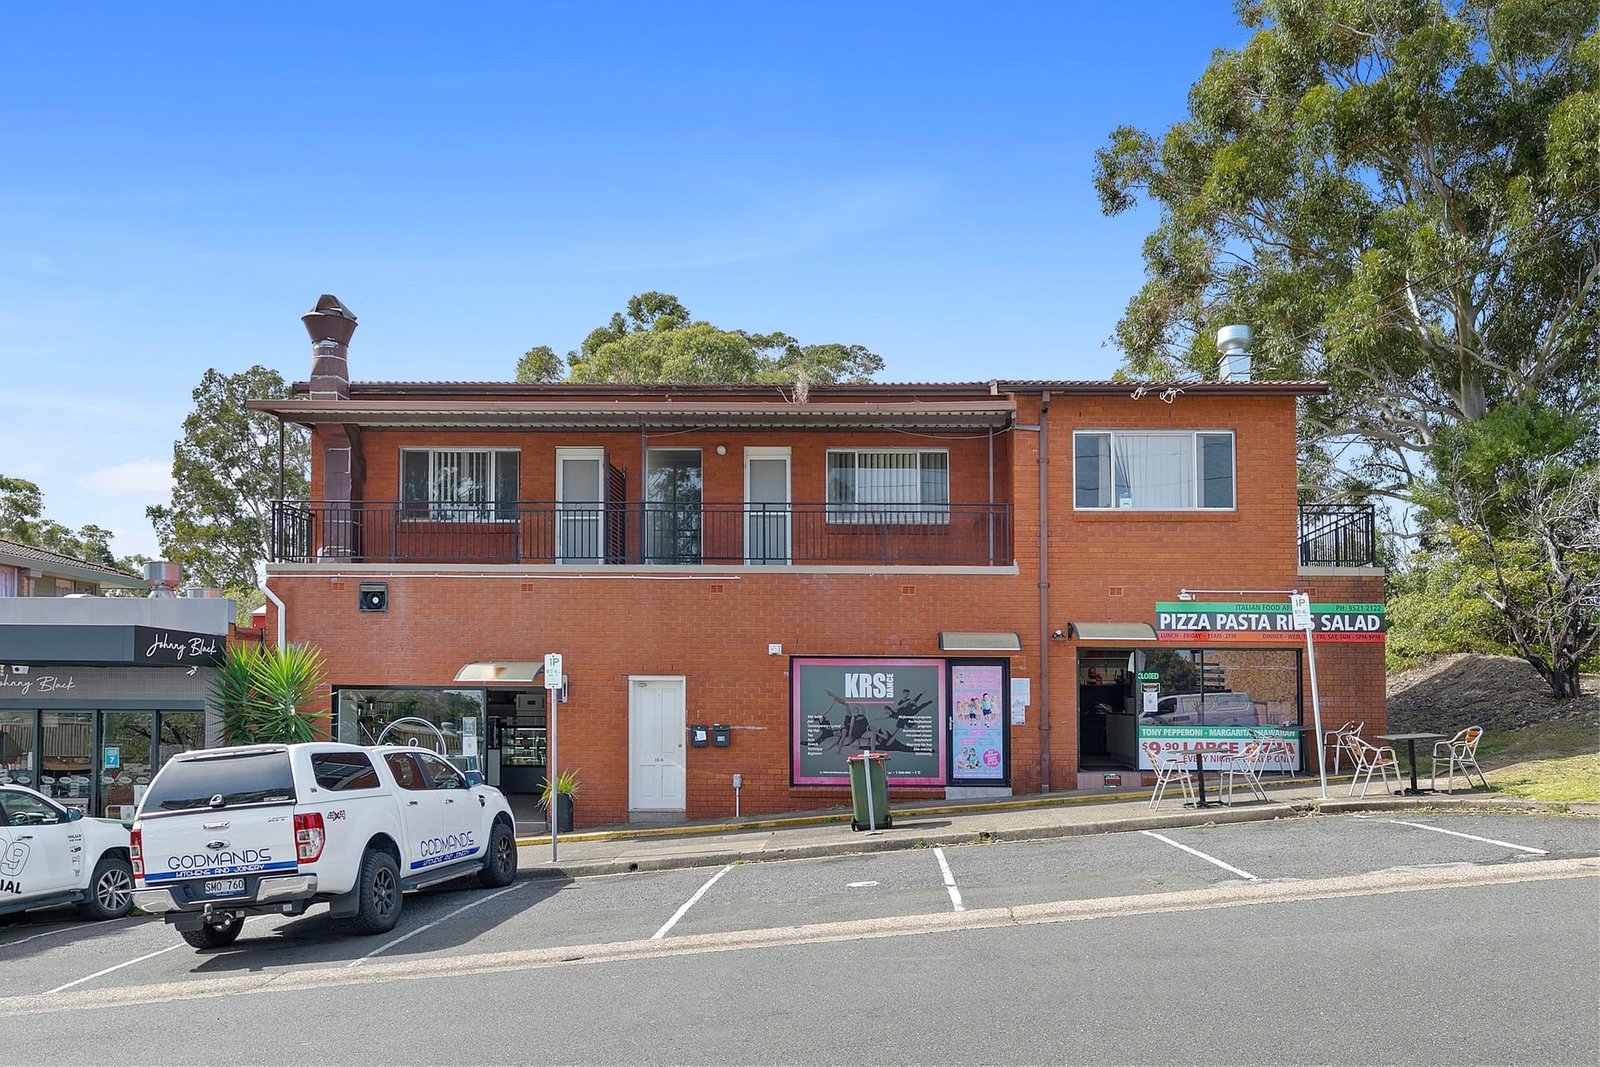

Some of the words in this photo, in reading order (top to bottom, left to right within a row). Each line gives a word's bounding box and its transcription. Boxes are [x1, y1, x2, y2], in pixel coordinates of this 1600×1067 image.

[1295, 599, 1306, 607] 1P
[1160, 613, 1211, 630] PIZZA
[1216, 614, 1271, 631] PASTA
[1276, 614, 1316, 631] RIS
[1321, 614, 1381, 632] SALAD
[146, 633, 187, 660] Johnny
[188, 637, 217, 656] Black
[549, 657, 560, 667] 1P
[1137, 672, 1159, 680] CLOSED
[36, 676, 76, 692] Black
[845, 672, 886, 698] KRS
[886, 673, 894, 698] DANCE
[1142, 728, 1162, 736] TONY
[1162, 728, 1203, 736] PEPPERONI
[1142, 742, 1179, 756] $9.90
[420, 831, 474, 858] GODMANDS
[168, 848, 272, 870] GODMANDS
[214, 866, 230, 874] AND
[205, 881, 222, 892] SMO
[228, 879, 244, 890] 760
